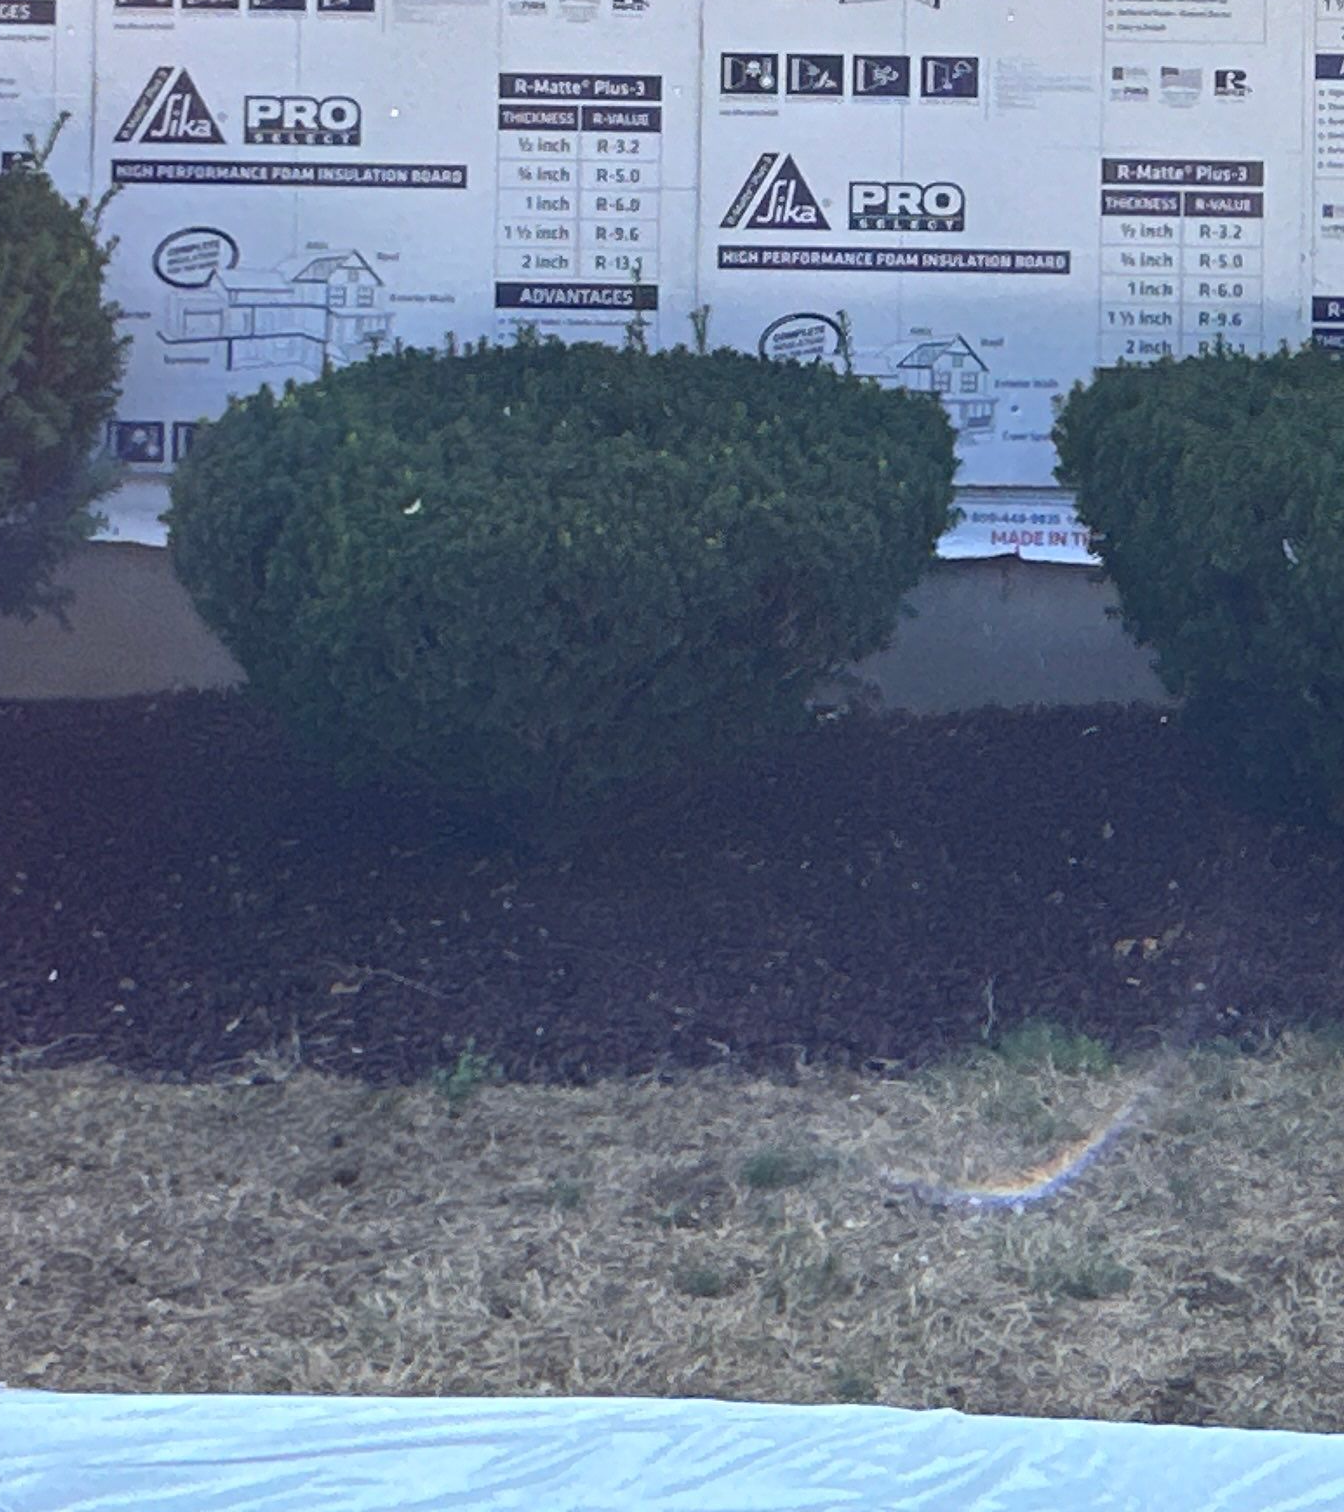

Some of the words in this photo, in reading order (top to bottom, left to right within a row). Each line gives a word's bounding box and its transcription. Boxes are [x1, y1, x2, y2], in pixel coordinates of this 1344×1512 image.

[151, 93, 211, 137] Sika
[247, 99, 359, 131] PRO
[757, 179, 816, 223] Sika
[852, 185, 962, 217] PRO
[520, 288, 634, 305] ADVANTAGES
